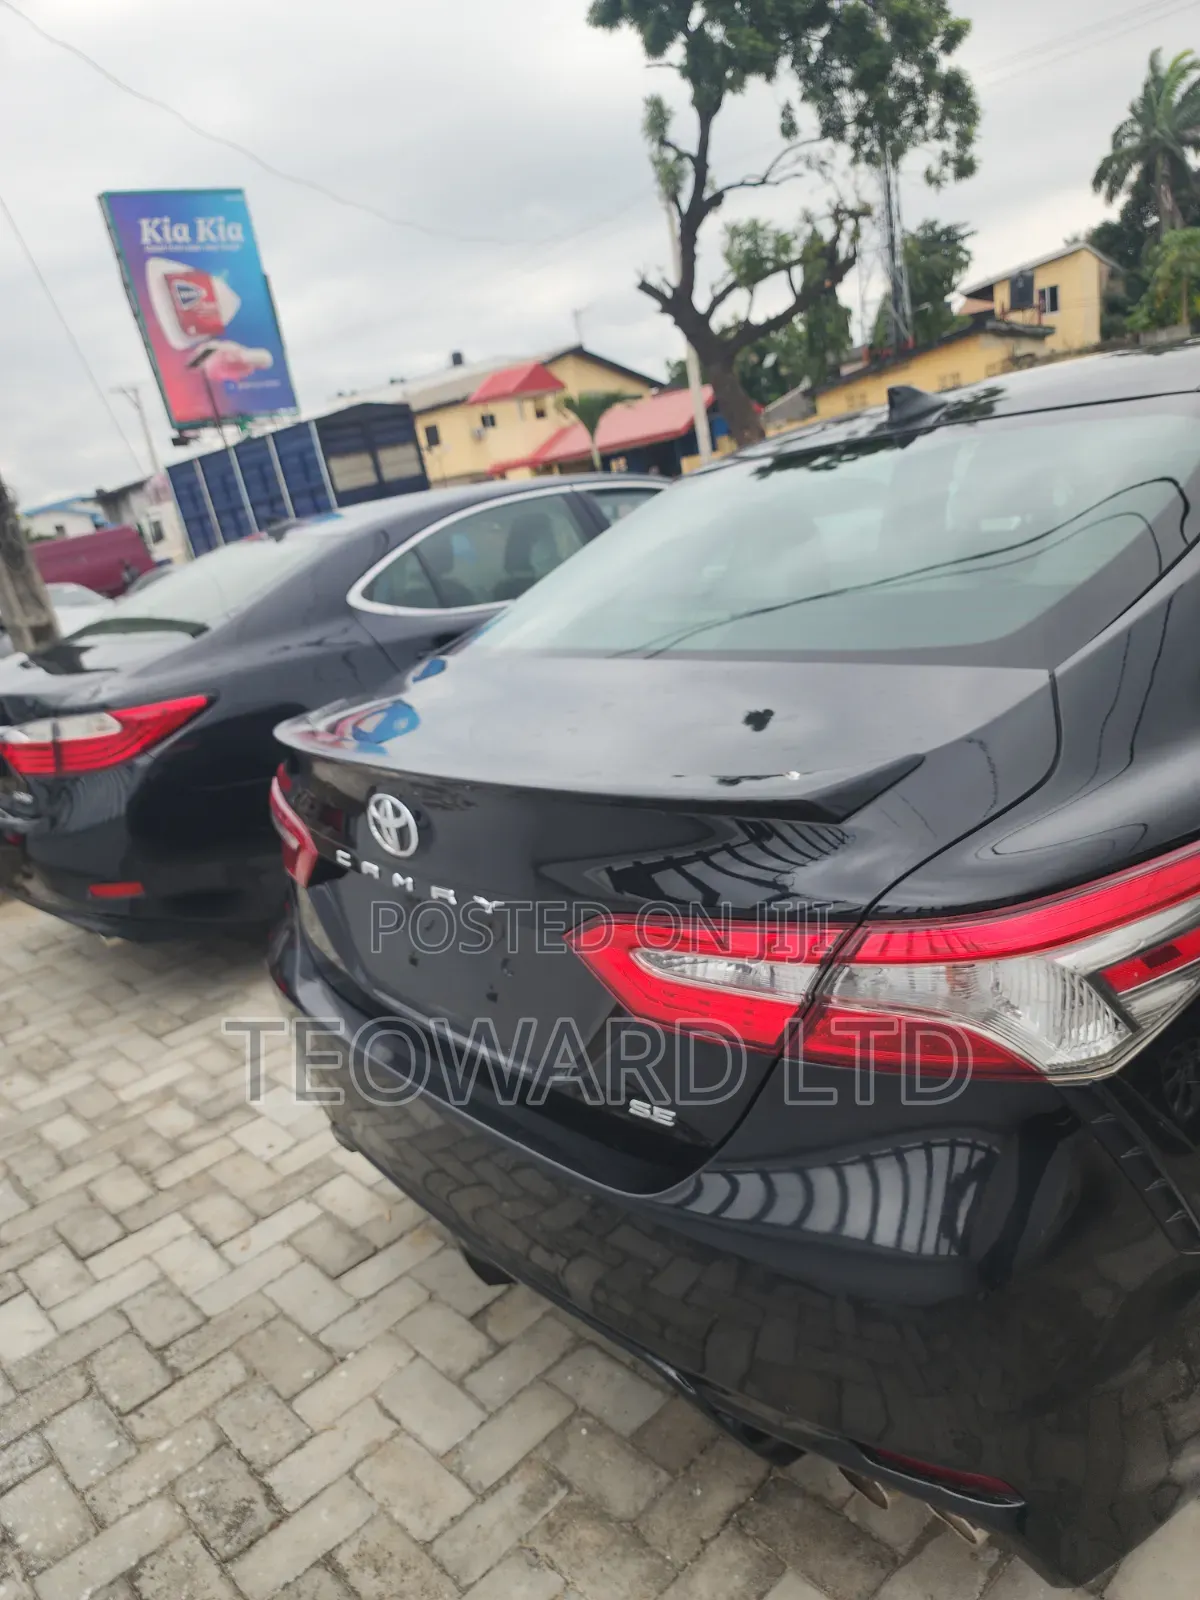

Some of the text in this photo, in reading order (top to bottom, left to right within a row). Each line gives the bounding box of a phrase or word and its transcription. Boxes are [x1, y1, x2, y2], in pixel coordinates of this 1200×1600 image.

[138, 215, 244, 245] Kia Kia
[335, 848, 506, 913] CAMRY
[628, 1098, 676, 1127] SE
